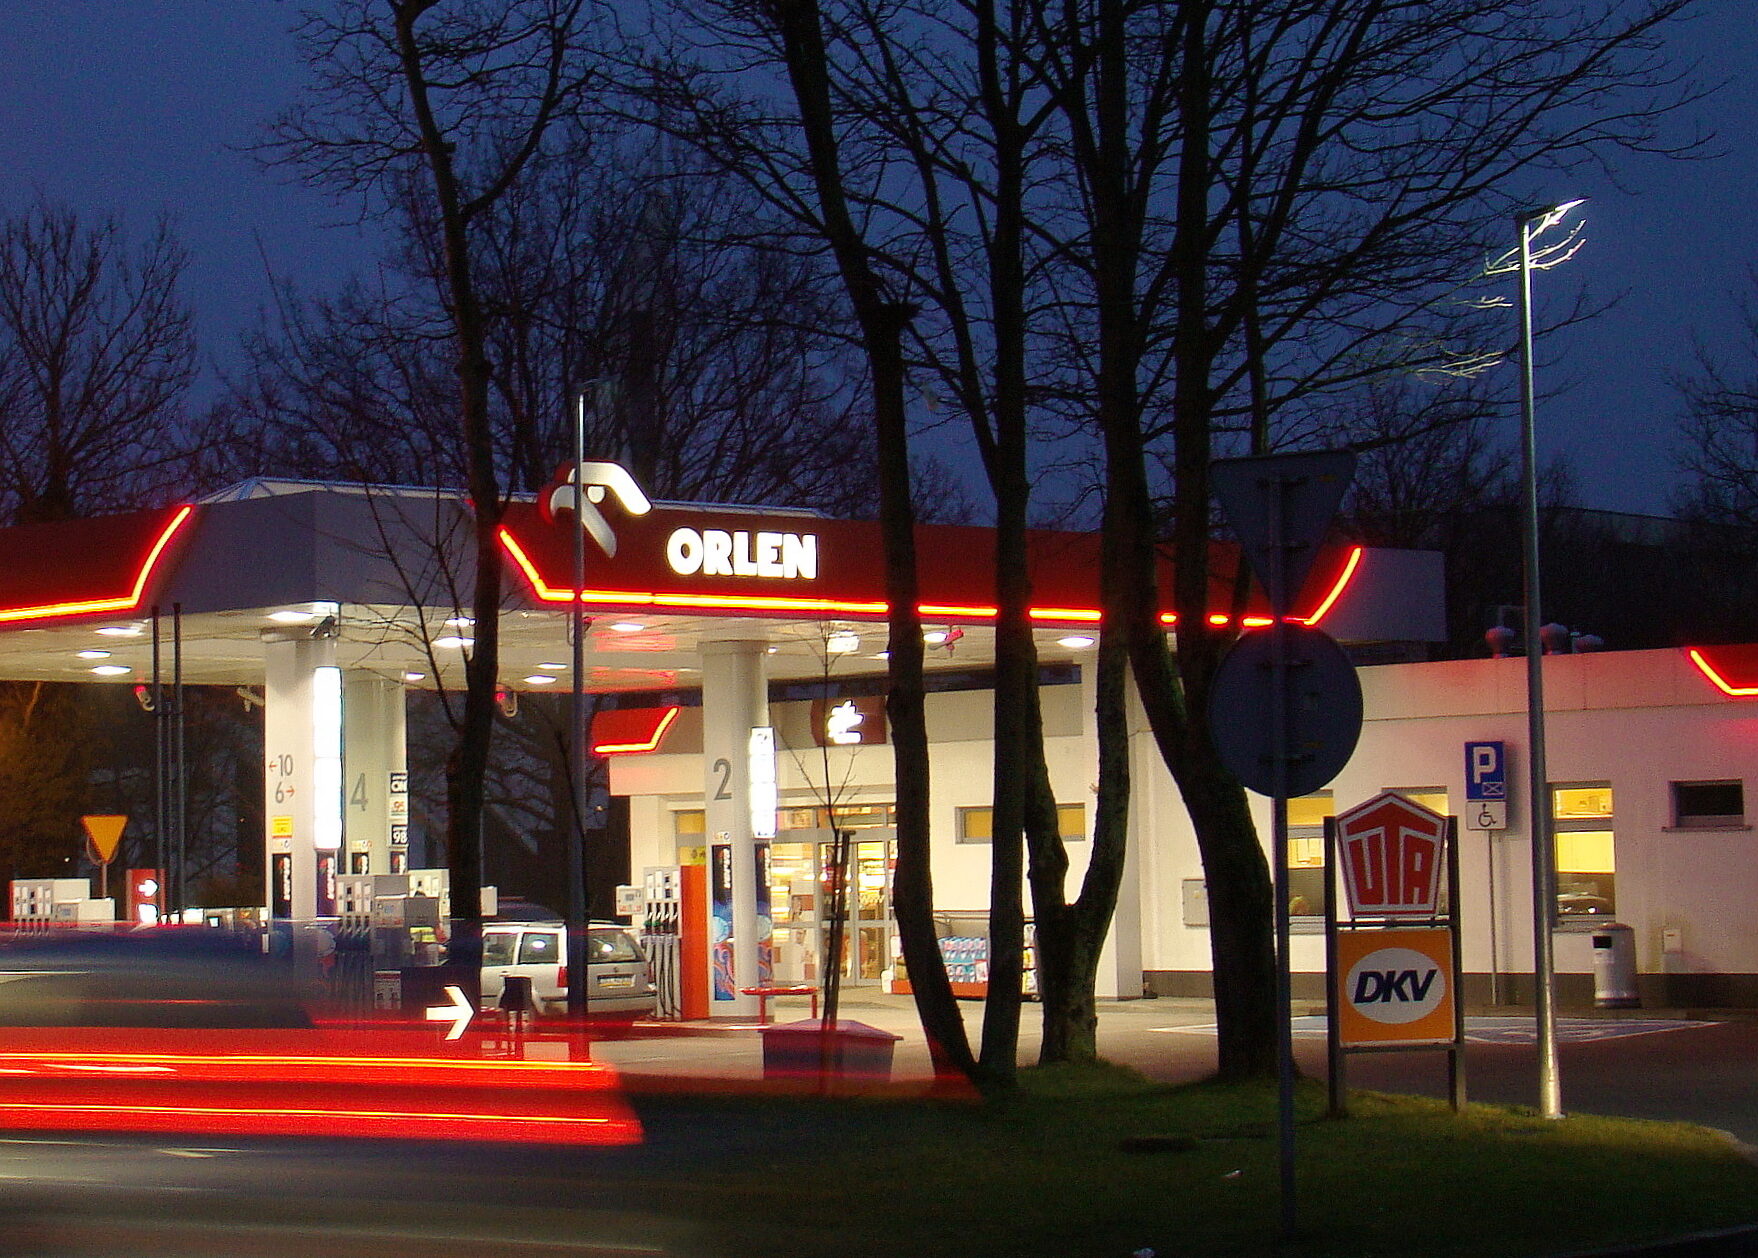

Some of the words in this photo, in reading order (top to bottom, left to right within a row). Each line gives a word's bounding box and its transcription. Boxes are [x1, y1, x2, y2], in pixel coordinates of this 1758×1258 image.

[667, 527, 817, 579] ORLEN
[278, 754, 293, 776] 10
[713, 758, 732, 800] 2
[1473, 746, 1496, 784] P
[275, 781, 285, 804] 6
[350, 772, 368, 812] 4
[1346, 801, 1437, 905] UTA
[1353, 969, 1437, 1003] DKV
